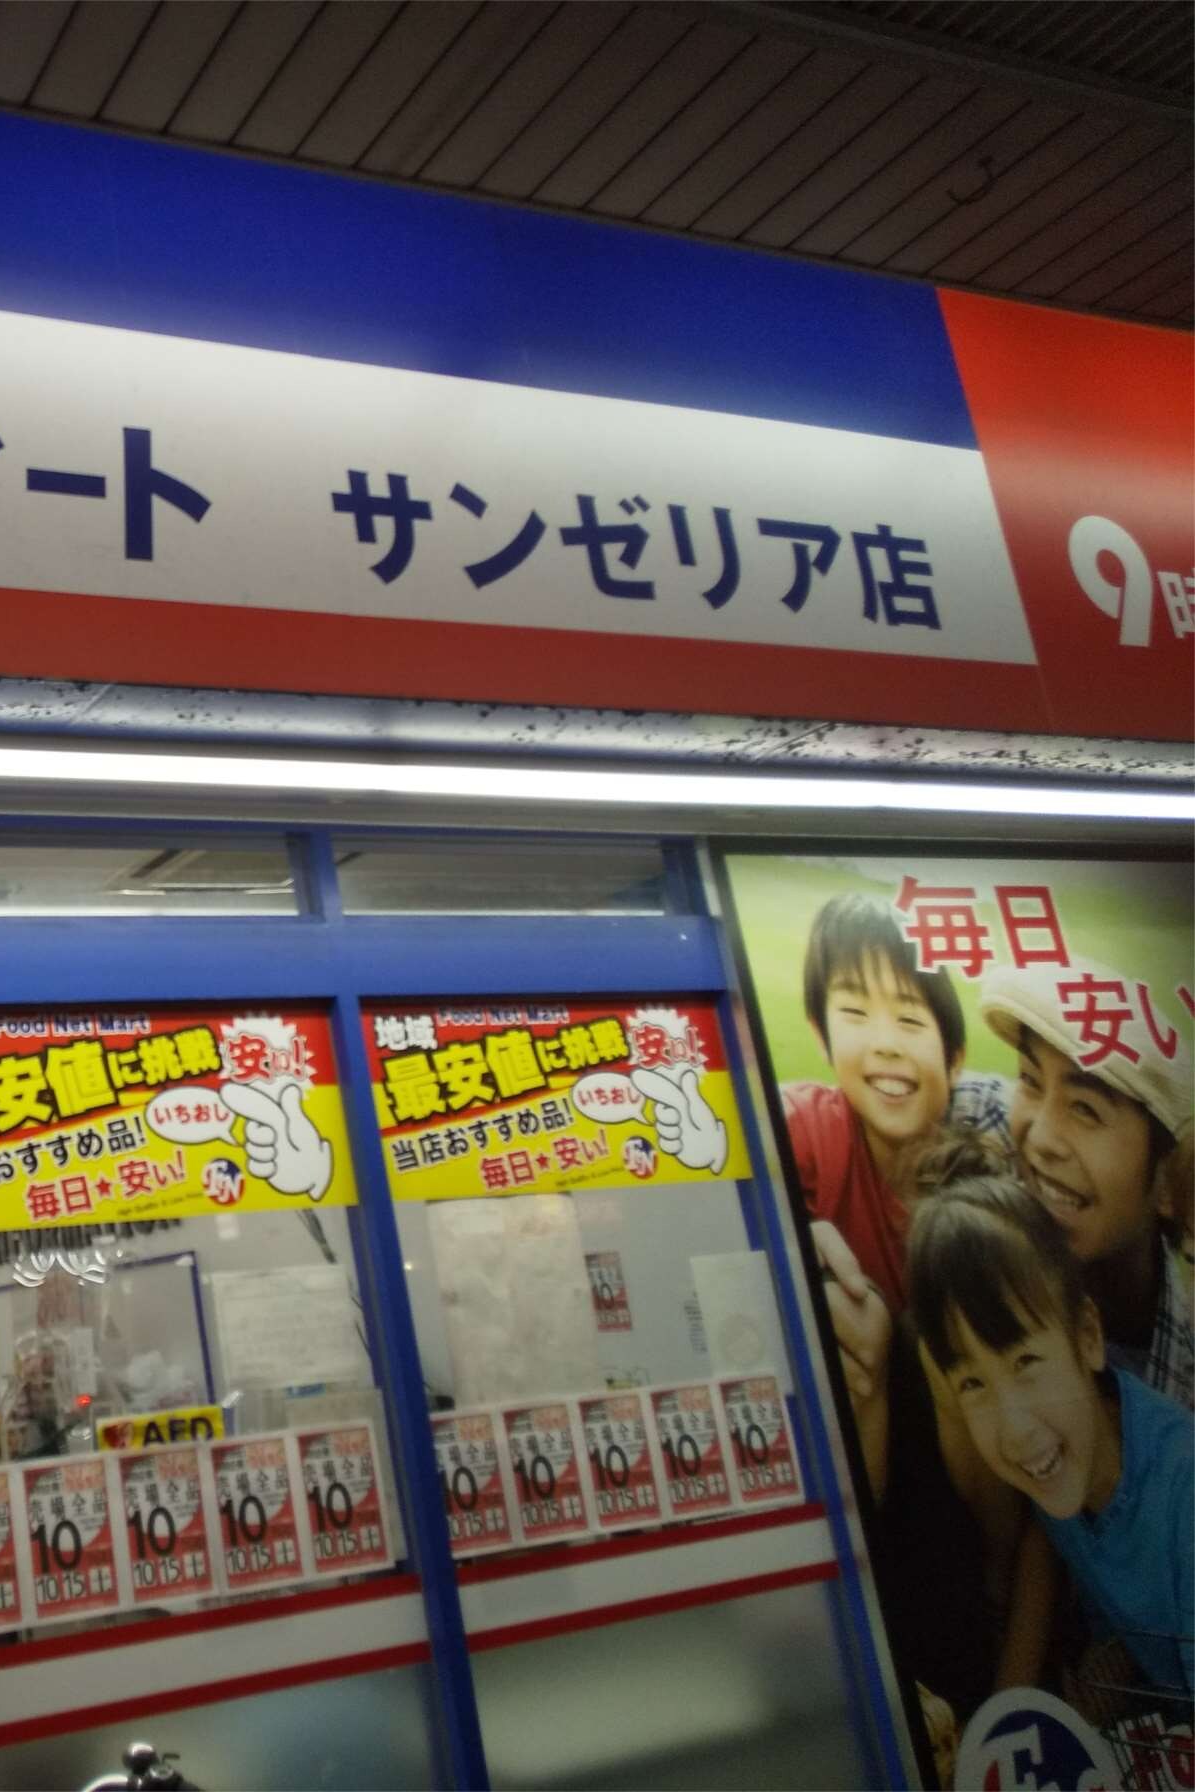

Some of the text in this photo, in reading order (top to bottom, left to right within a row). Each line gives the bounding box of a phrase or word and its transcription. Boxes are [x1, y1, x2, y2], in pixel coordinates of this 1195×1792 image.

[331, 469, 942, 630] サンゼリア店
[896, 876, 1069, 977] 毎日
[53, 1014, 93, 1036] Net
[97, 1013, 150, 1034] Mart
[375, 1015, 437, 1050] 地域
[384, 1018, 629, 1122] 最安値に挑戦
[579, 1088, 640, 1106] いちおし
[154, 1104, 229, 1124] いちおし
[393, 1098, 574, 1171] 当店おすすめ品!
[228, 1548, 248, 1572] 10
[253, 1544, 271, 1569] 15
[314, 1535, 333, 1557] 10
[339, 1530, 358, 1553] 15
[134, 1561, 155, 1585] 10
[160, 1557, 180, 1581] 15
[37, 1575, 59, 1601] 10
[64, 1571, 85, 1598] 15
